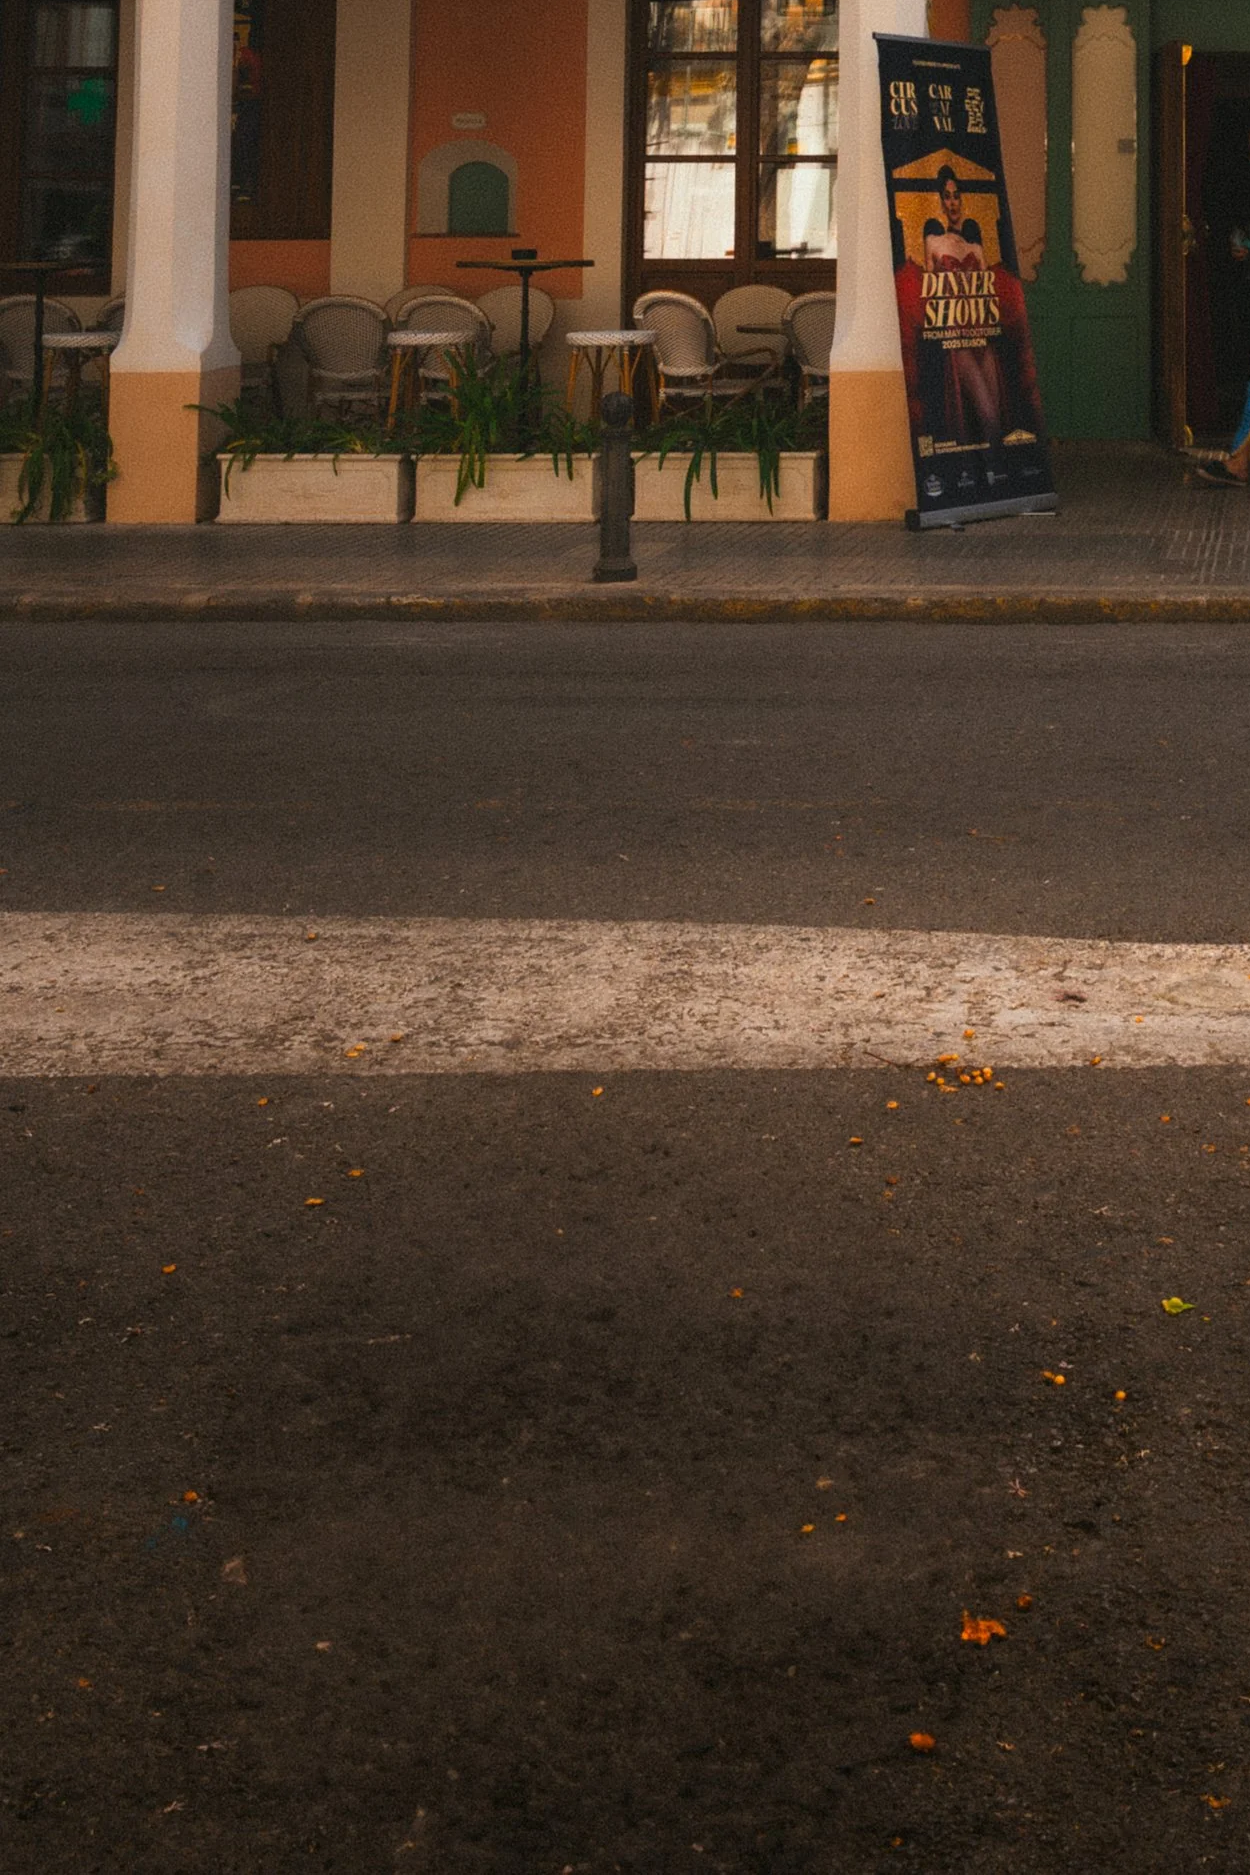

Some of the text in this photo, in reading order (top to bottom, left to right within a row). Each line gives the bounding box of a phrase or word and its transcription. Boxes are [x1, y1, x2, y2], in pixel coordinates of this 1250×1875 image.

[889, 81, 916, 99] CIR
[890, 98, 918, 116] CUS
[921, 271, 996, 298] DINNER
[924, 297, 1000, 328] SHOWS
[945, 329, 961, 338] MAY
